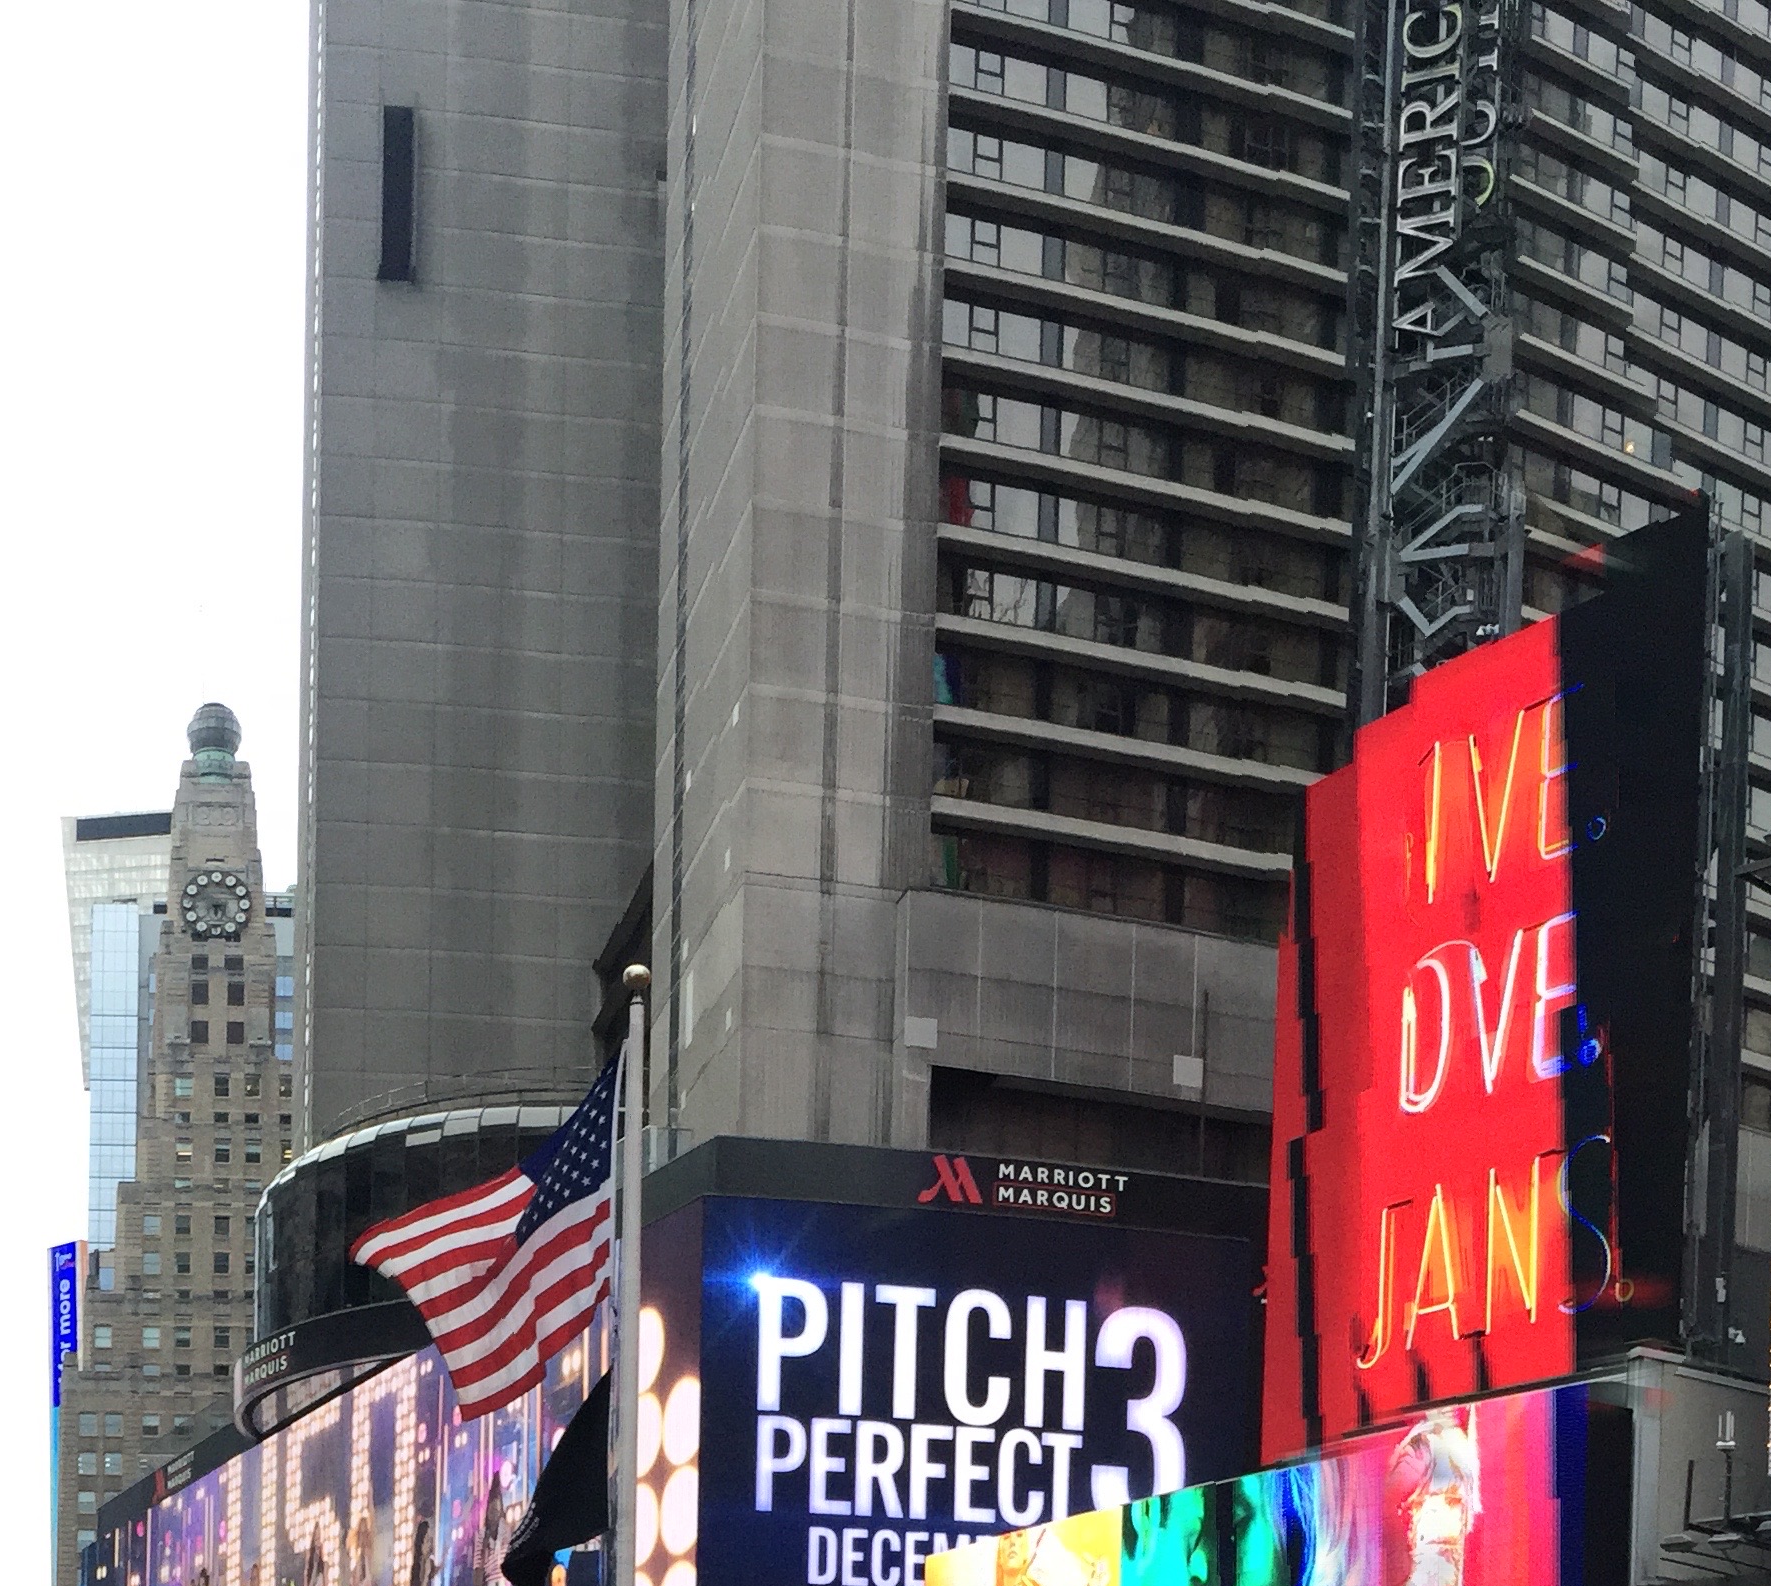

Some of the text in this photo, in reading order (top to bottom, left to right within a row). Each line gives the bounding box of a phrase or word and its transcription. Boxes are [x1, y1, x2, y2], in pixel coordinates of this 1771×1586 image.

[998, 1162, 1129, 1191] MARRIOTT
[998, 1187, 1112, 1214] MARQUIS
[756, 1275, 1087, 1430] PITCH
[1090, 1306, 1187, 1511] 3
[755, 1415, 1083, 1526] PERFECT
